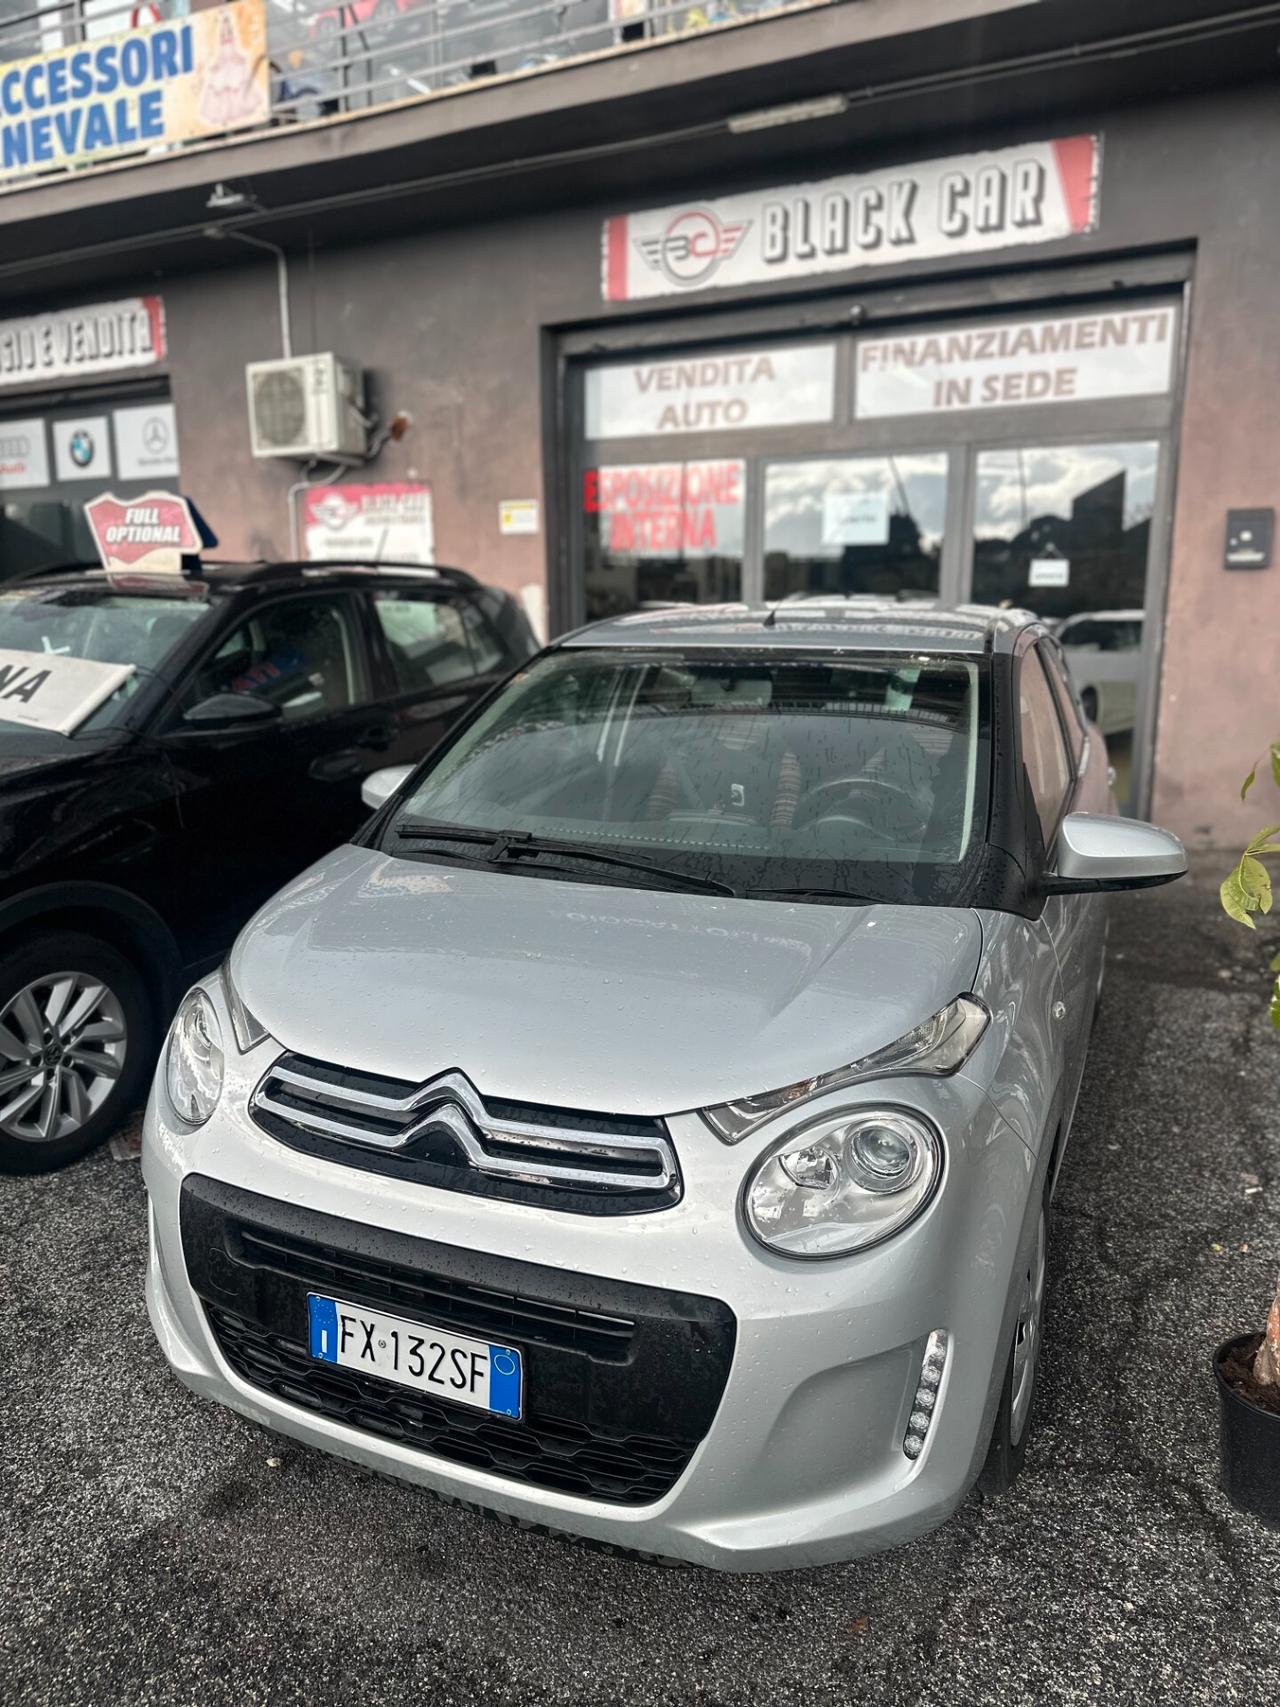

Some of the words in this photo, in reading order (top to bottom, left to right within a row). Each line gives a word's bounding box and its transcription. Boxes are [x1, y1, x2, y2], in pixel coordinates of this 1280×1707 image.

[0, 25, 194, 116] CCESSORI
[1, 90, 165, 168] NEVALE
[762, 178, 918, 264] BLACK
[938, 158, 1046, 237] CAR
[60, 311, 153, 364] VENDITA
[860, 312, 1169, 372] FINANZIAMENTI
[634, 356, 776, 394] VENDITA
[932, 377, 972, 407] IN
[979, 368, 1078, 402] SEDE
[656, 398, 749, 429] AUTO
[582, 463, 740, 513] ESPOSIZIONE
[105, 525, 182, 544] OPTIONAL
[125, 507, 160, 525] FULL
[609, 507, 718, 553] INTERNA
